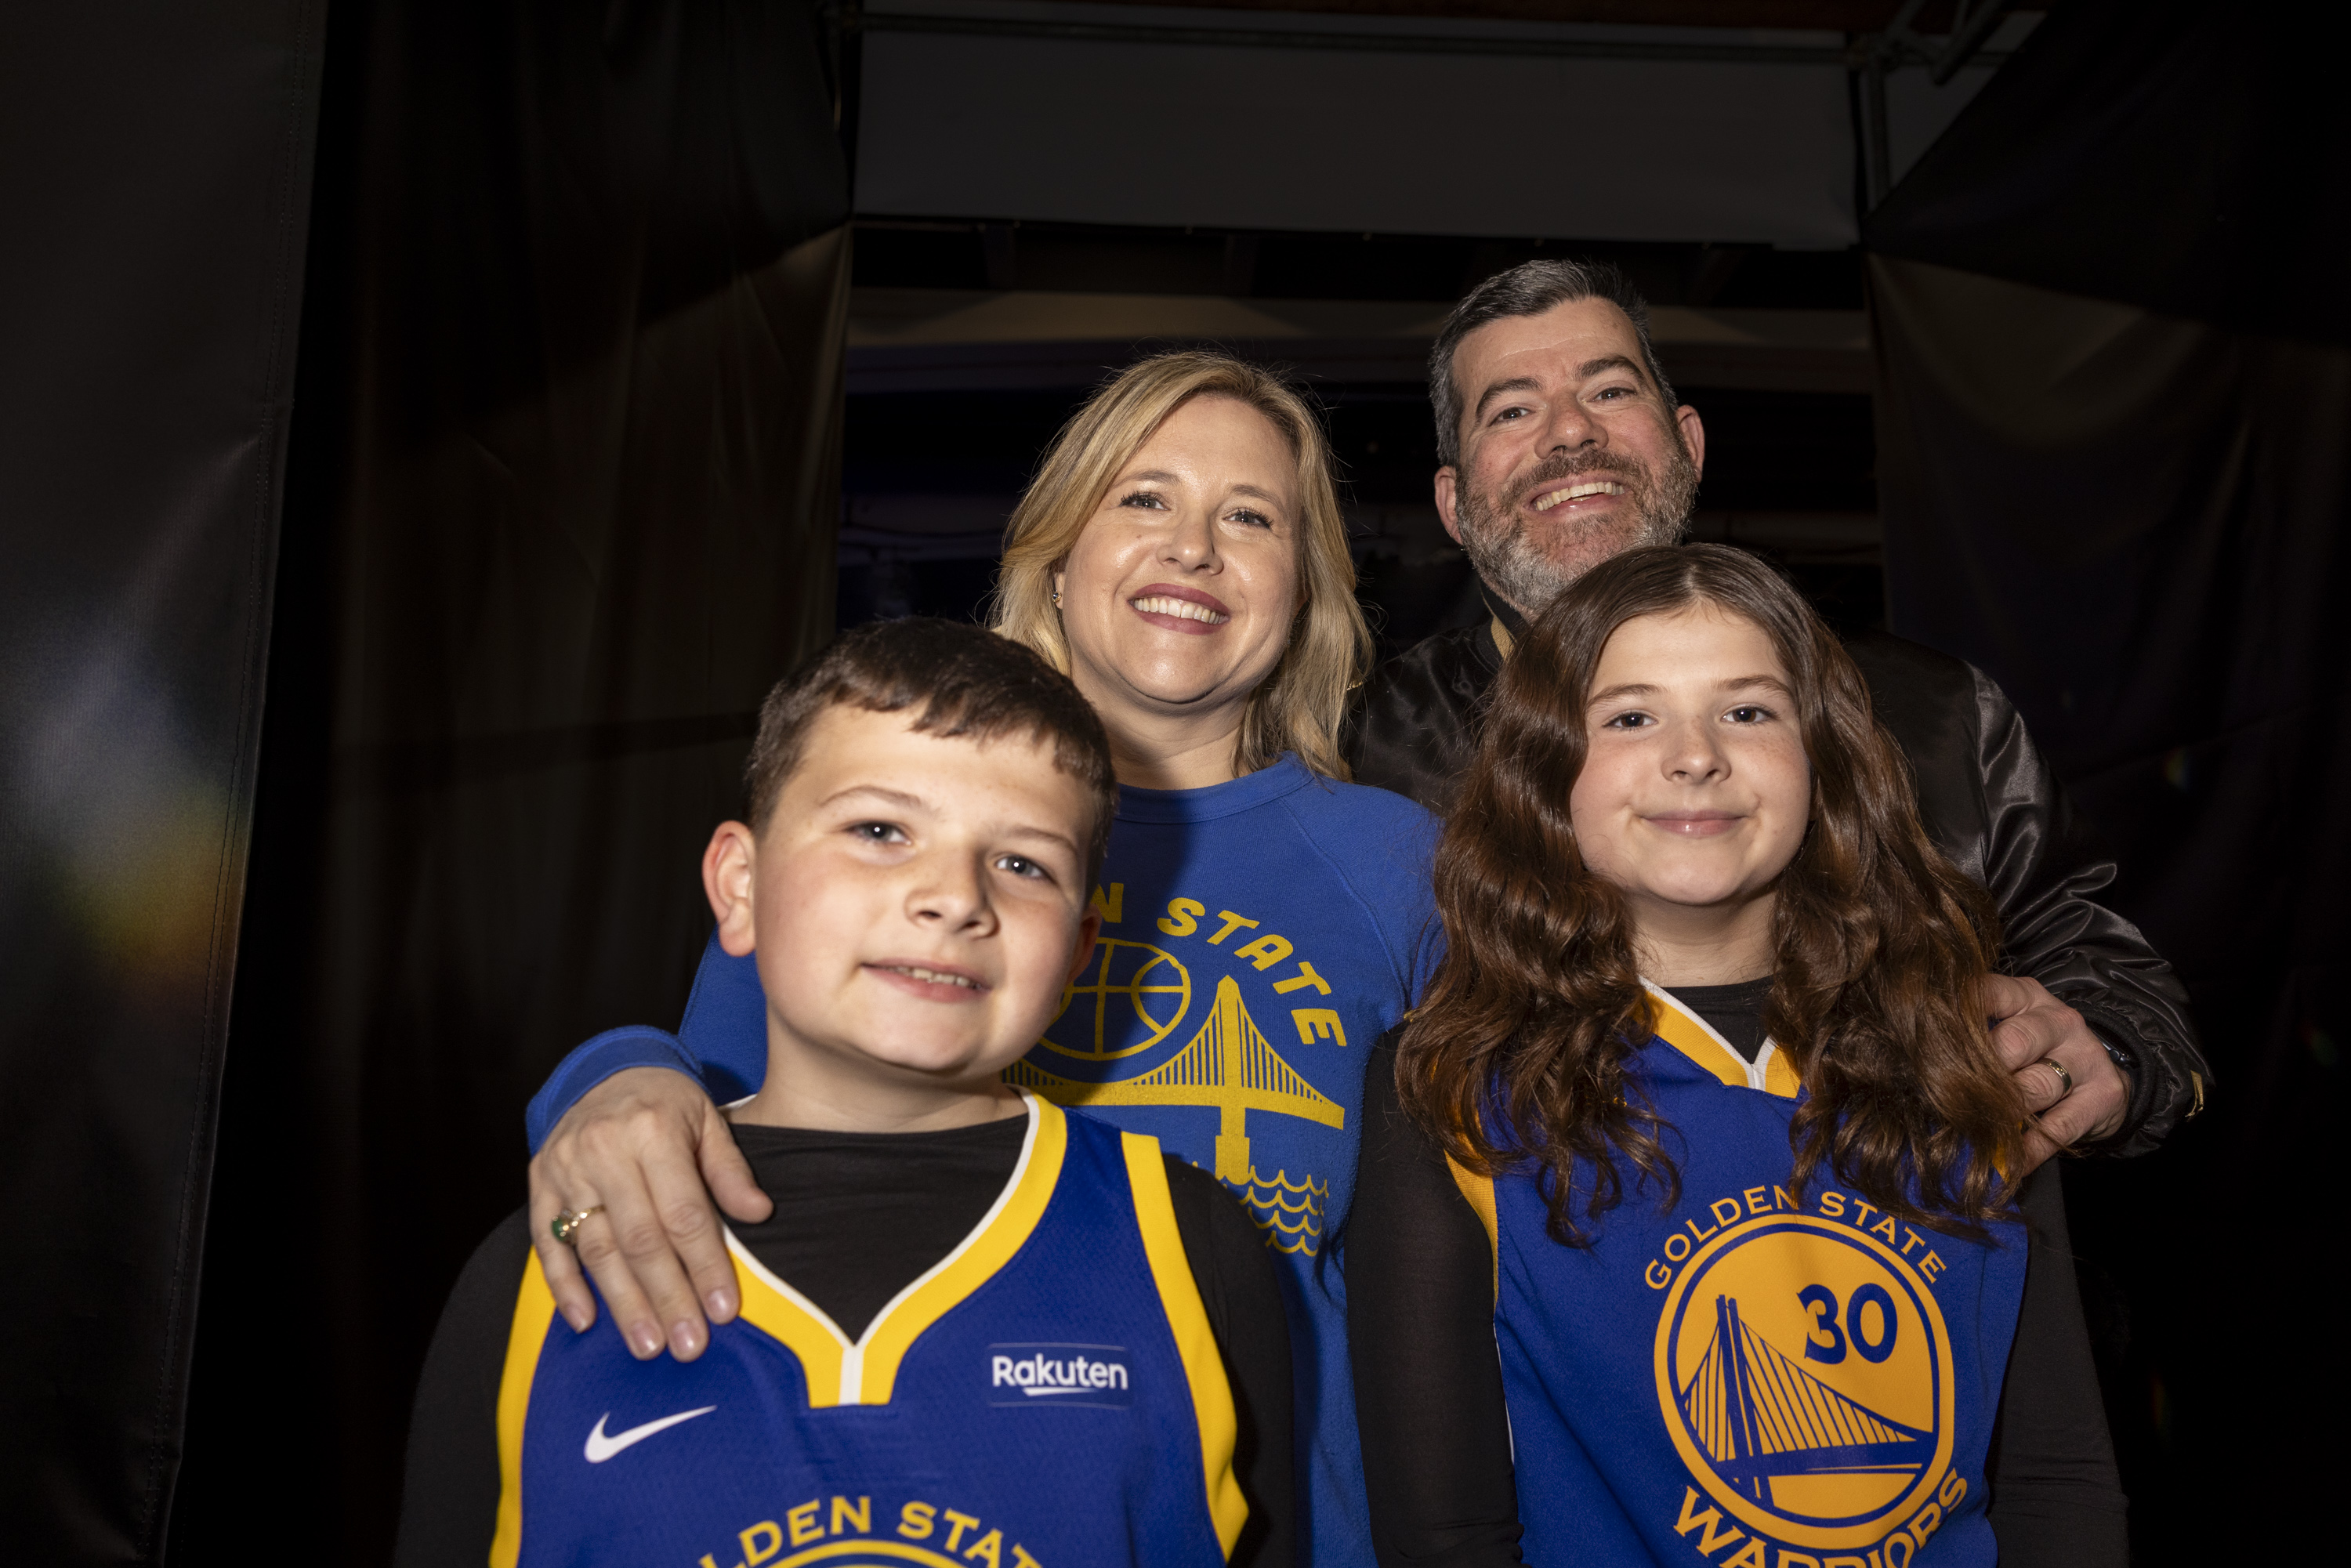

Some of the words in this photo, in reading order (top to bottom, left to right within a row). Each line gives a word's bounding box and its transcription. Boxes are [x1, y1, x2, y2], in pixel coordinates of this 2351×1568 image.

[1157, 897, 1347, 1047] STATE
[1645, 1185, 1800, 1291] GOLDEN
[1818, 1190, 1947, 1284] STATE
[992, 1353, 1128, 1390] Rakuten
[1796, 1283, 1897, 1364] 30
[1672, 1467, 1969, 1568] WAORS
